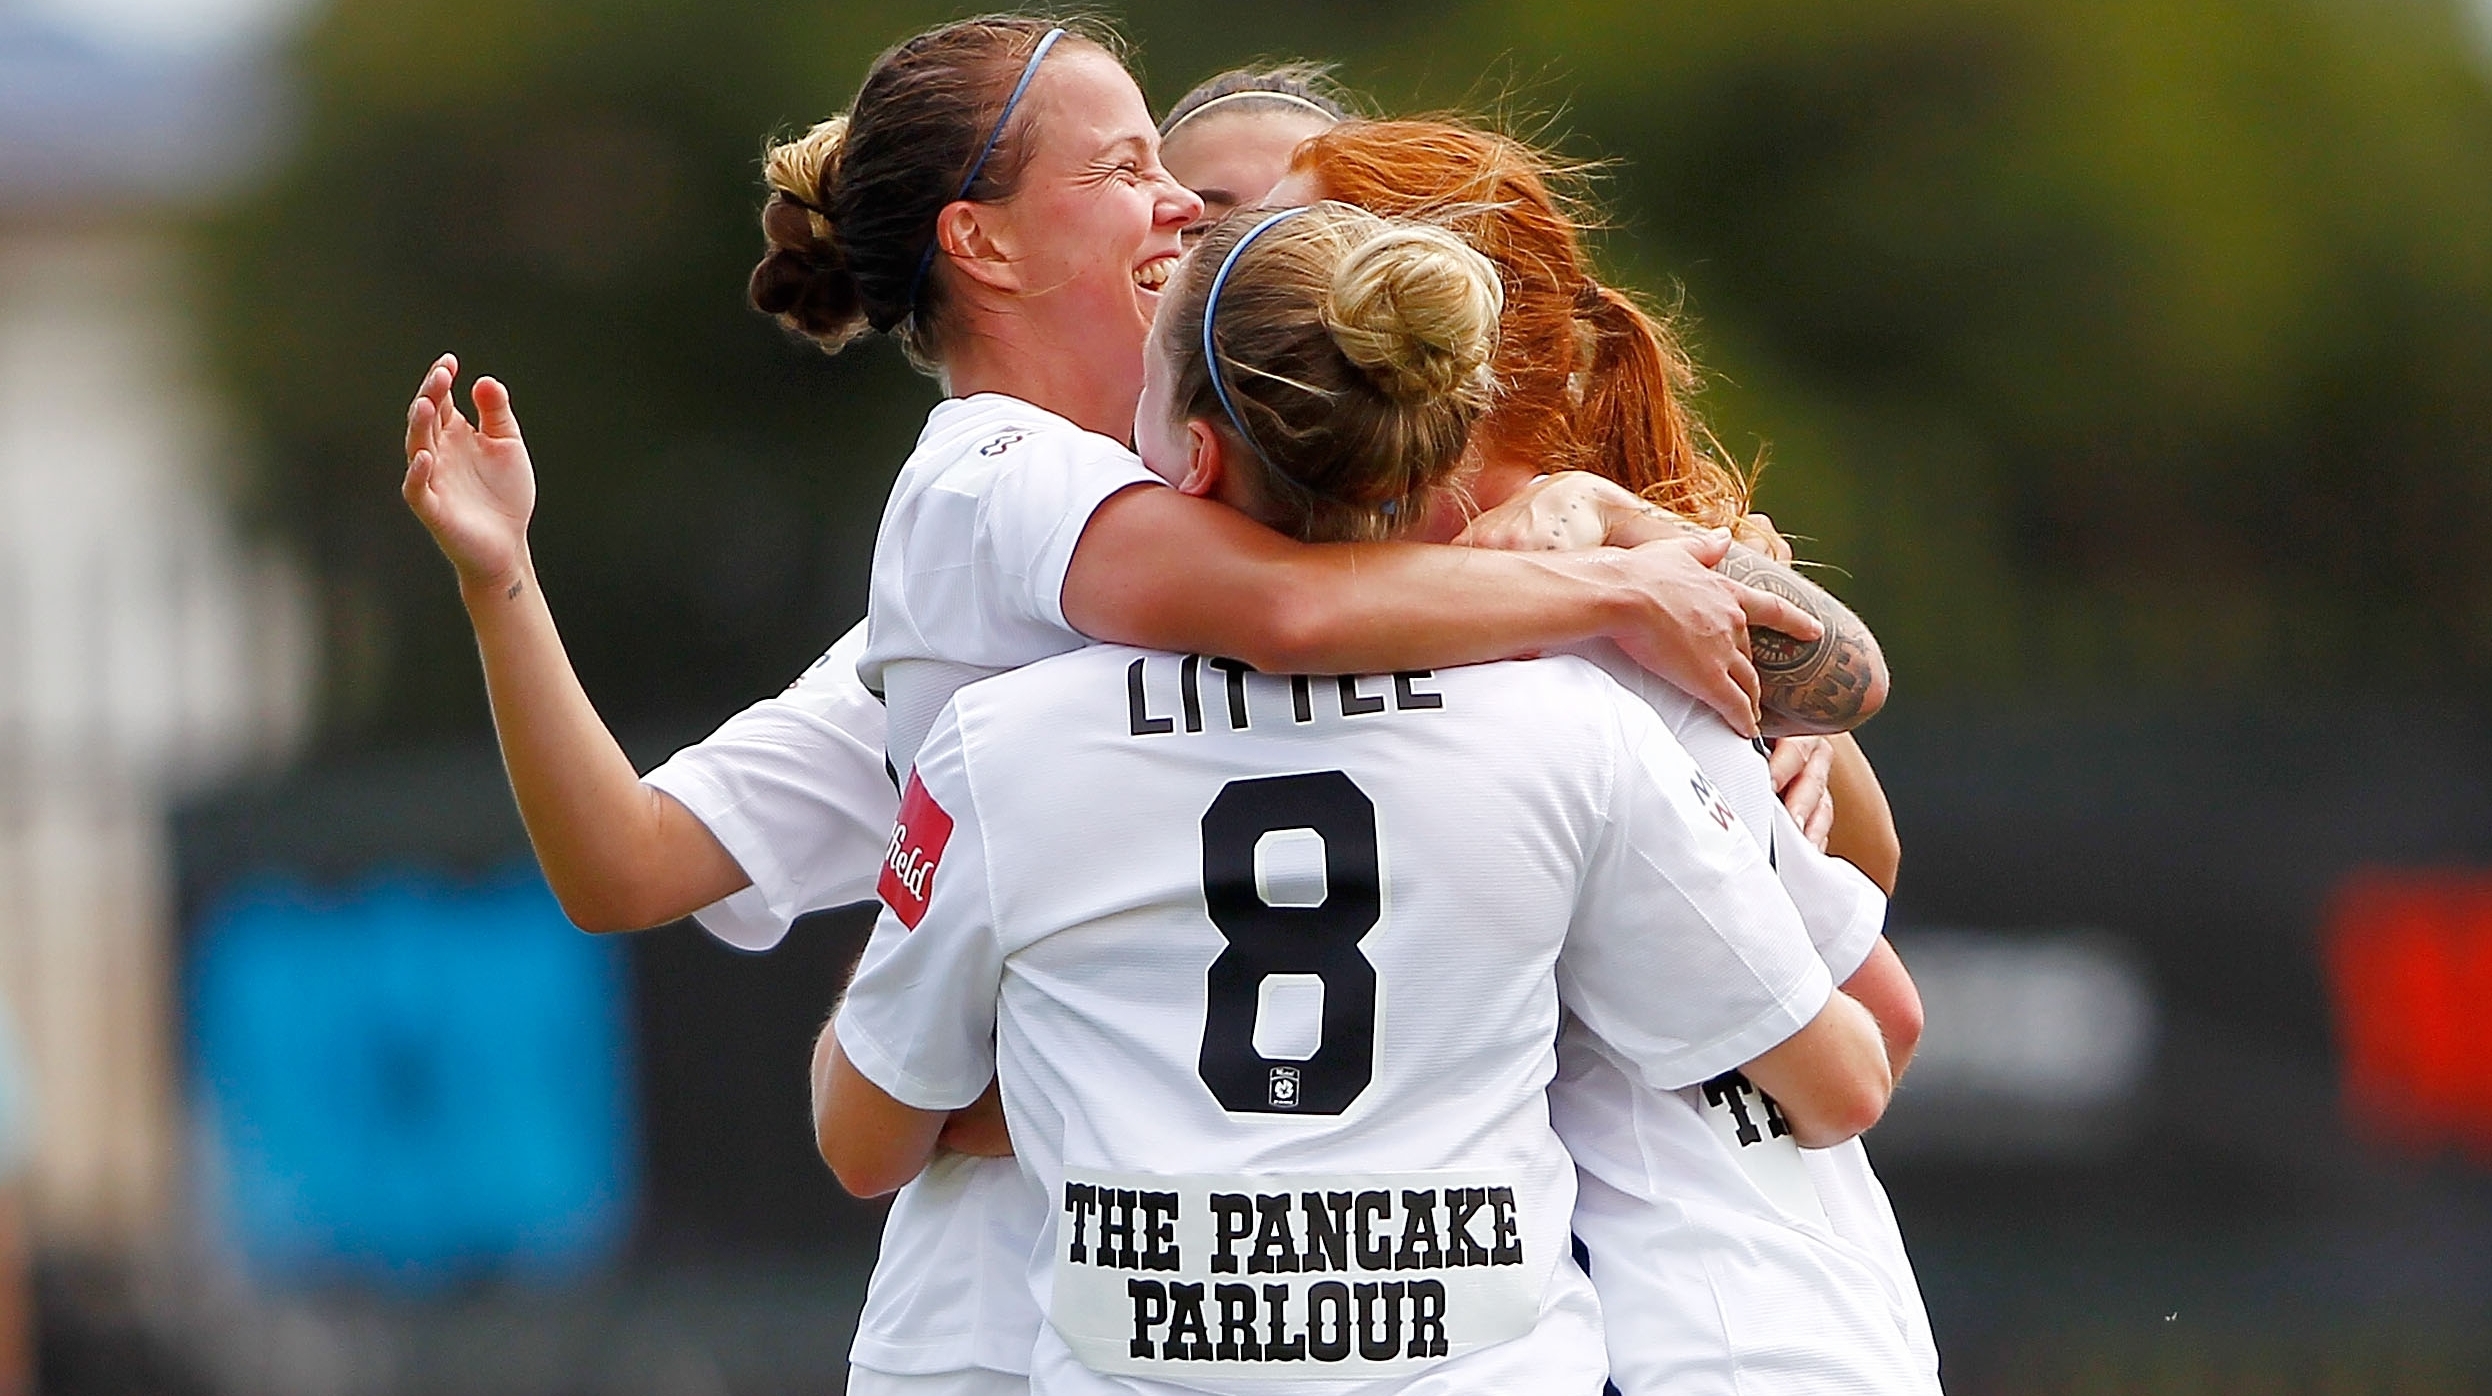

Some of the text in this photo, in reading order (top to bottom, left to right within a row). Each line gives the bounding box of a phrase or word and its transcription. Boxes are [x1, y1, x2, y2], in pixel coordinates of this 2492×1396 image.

[1198, 769, 1382, 1117] 8
[1063, 1180, 1524, 1276] THE PANCAKE
[1127, 1277, 1450, 1363] PARLOUR
